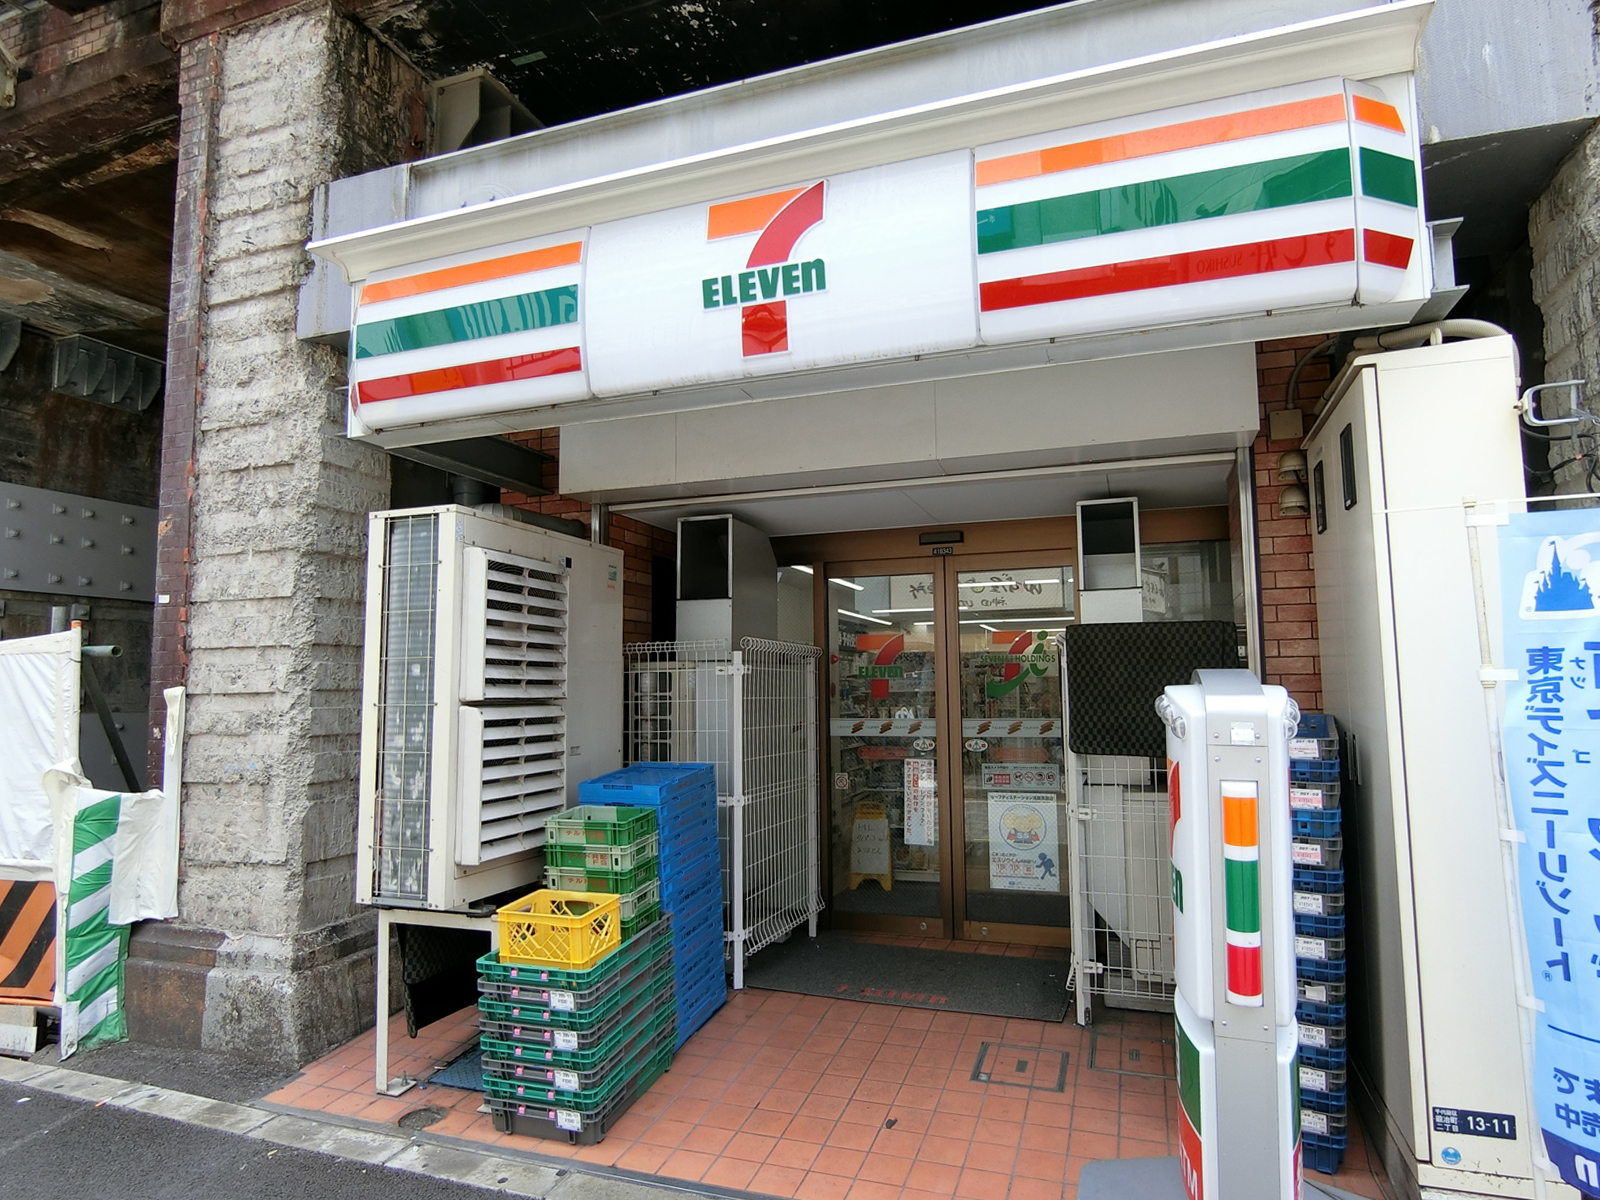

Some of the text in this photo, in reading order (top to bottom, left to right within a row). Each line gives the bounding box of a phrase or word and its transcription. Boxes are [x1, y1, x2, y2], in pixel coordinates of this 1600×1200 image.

[707, 180, 825, 357] 7
[1015, 654, 1056, 663] HOLDINGS
[1434, 1108, 1458, 1117] 千代田区
[1435, 1115, 1458, 1125] 鍛冶町
[1436, 1123, 1459, 1132] 二丁目
[1467, 1115, 1510, 1135] 13-11
